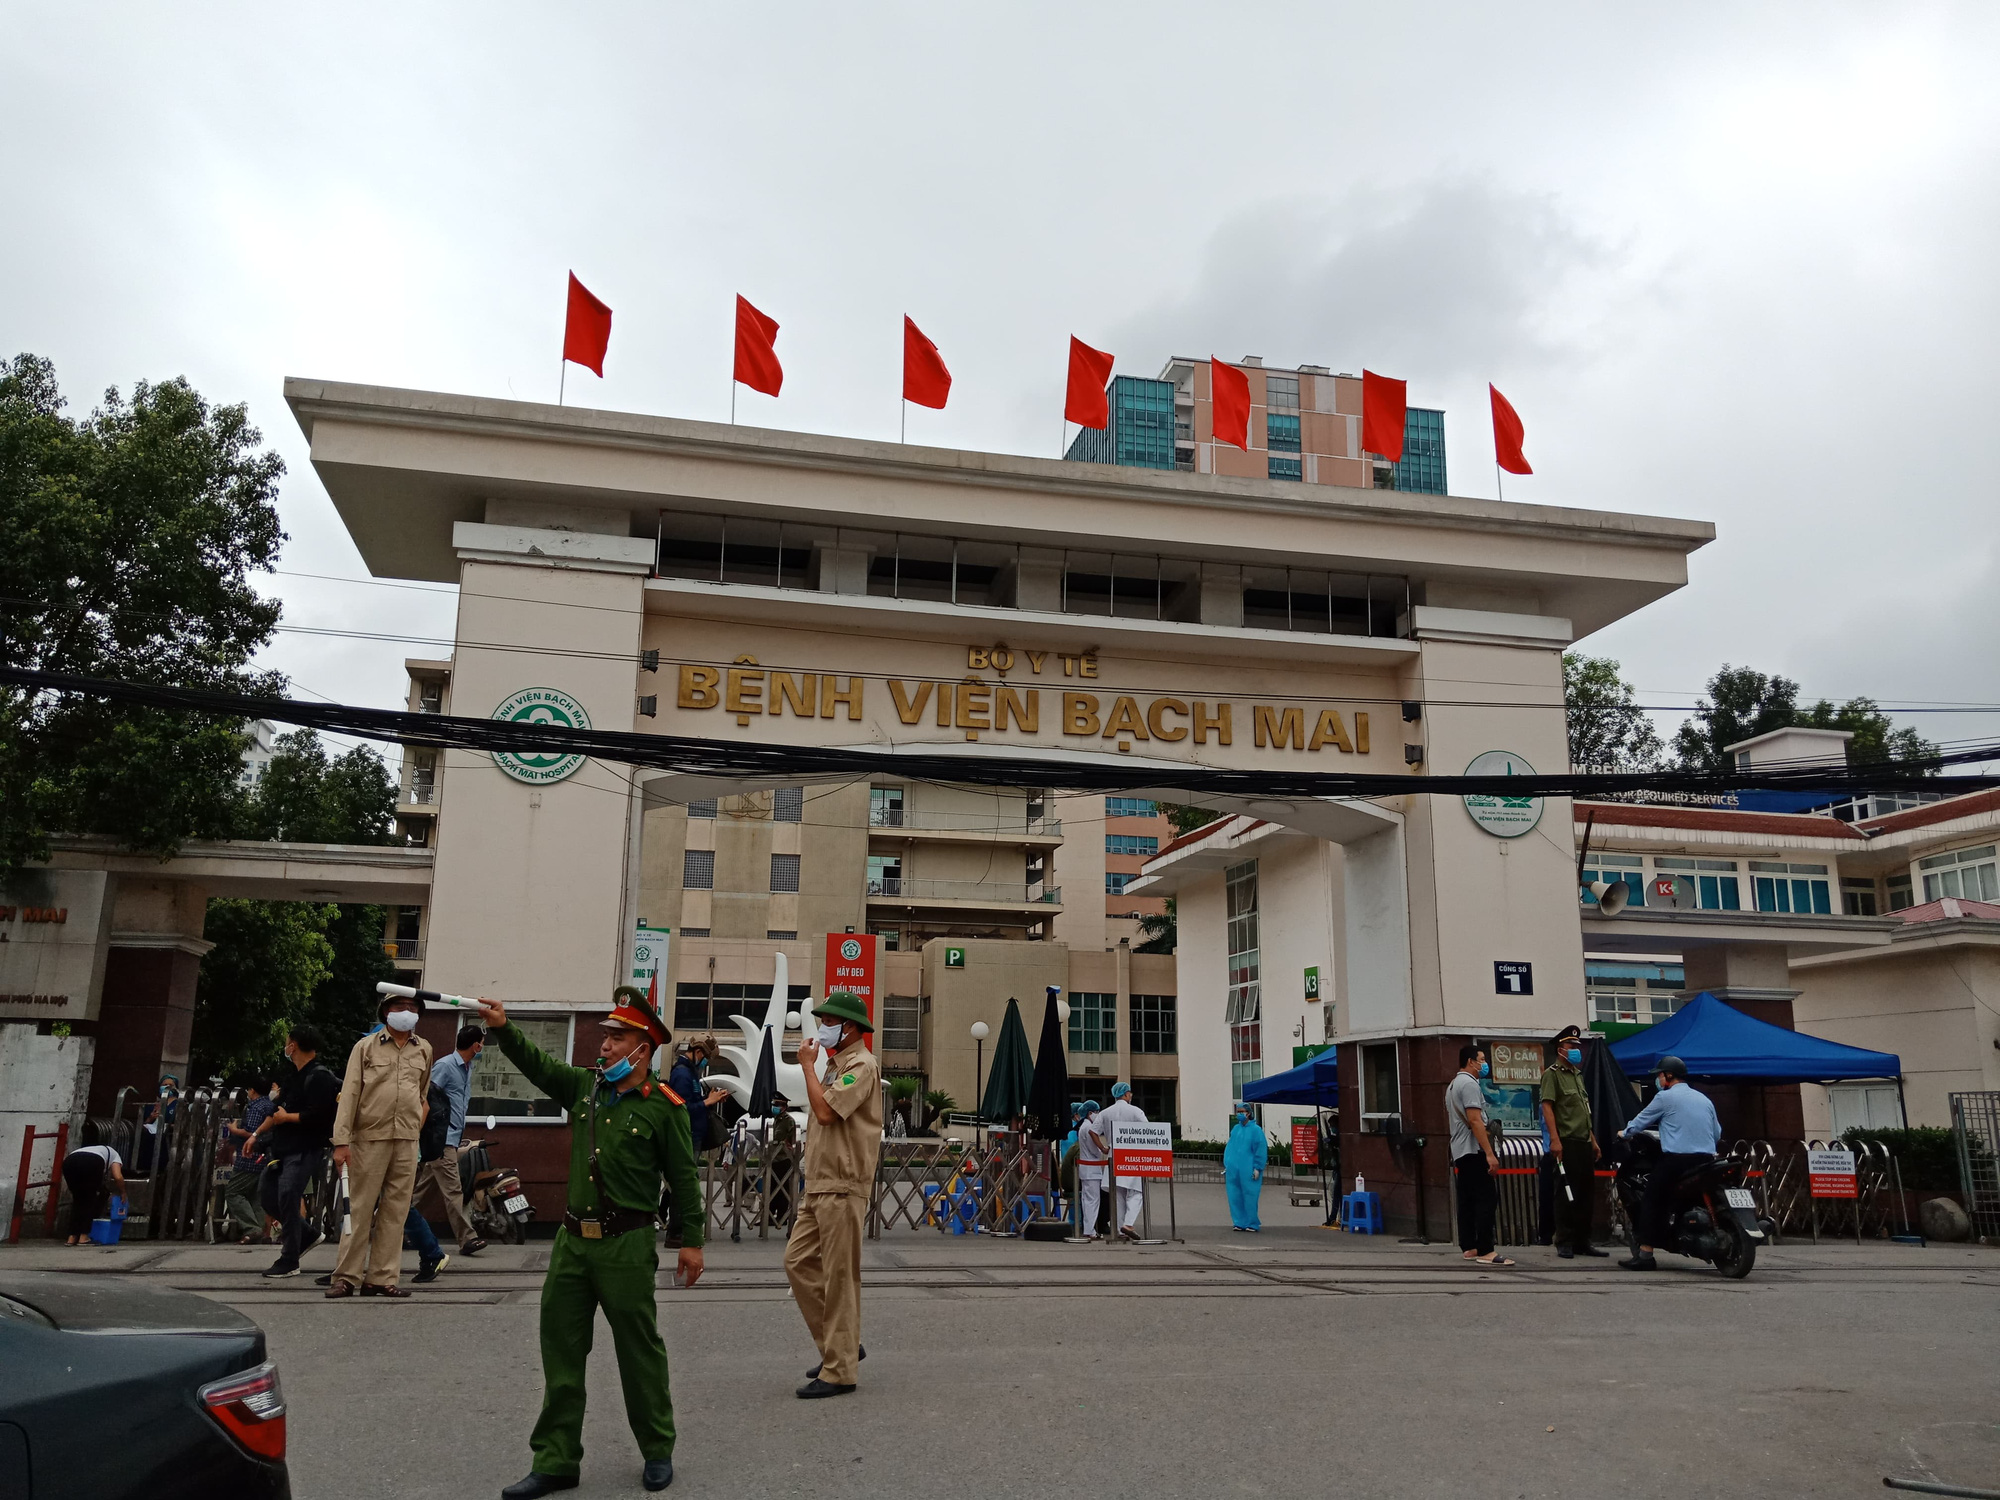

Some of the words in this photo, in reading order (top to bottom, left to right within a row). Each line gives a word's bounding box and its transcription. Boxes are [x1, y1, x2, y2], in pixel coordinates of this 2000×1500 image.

[968, 642, 1015, 678] BỘ
[1025, 650, 1048, 674] Y
[1058, 644, 1100, 678] TẾ
[515, 692, 541, 705] VIỆN
[544, 693, 573, 711] BẠCH
[677, 654, 864, 726] BỆNH
[887, 675, 1039, 741] VIỆN
[1063, 692, 1232, 751] BẠCH
[1253, 705, 1370, 753] MAI
[518, 767, 538, 779] MAI
[541, 753, 581, 779] HOSPITA
[1636, 789, 1688, 803] REQUIRED
[1690, 793, 1740, 806] SERVICES
[23, 906, 68, 924] MAI
[949, 949, 961, 965] P
[836, 965, 850, 977] HÃY
[848, 985, 871, 995] TRANG
[1305, 975, 1317, 993] K3
[1503, 974, 1521, 992] 1
[1514, 1048, 1538, 1061] CẤM
[1510, 1064, 1532, 1079] THUỐC
[1128, 1127, 1142, 1135] LÒNG
[1142, 1127, 1157, 1136] DỪNG
[1157, 1129, 1166, 1137] LẠI
[1123, 1136, 1136, 1144] KIỂM
[1146, 1137, 1161, 1146] NHIỆT
